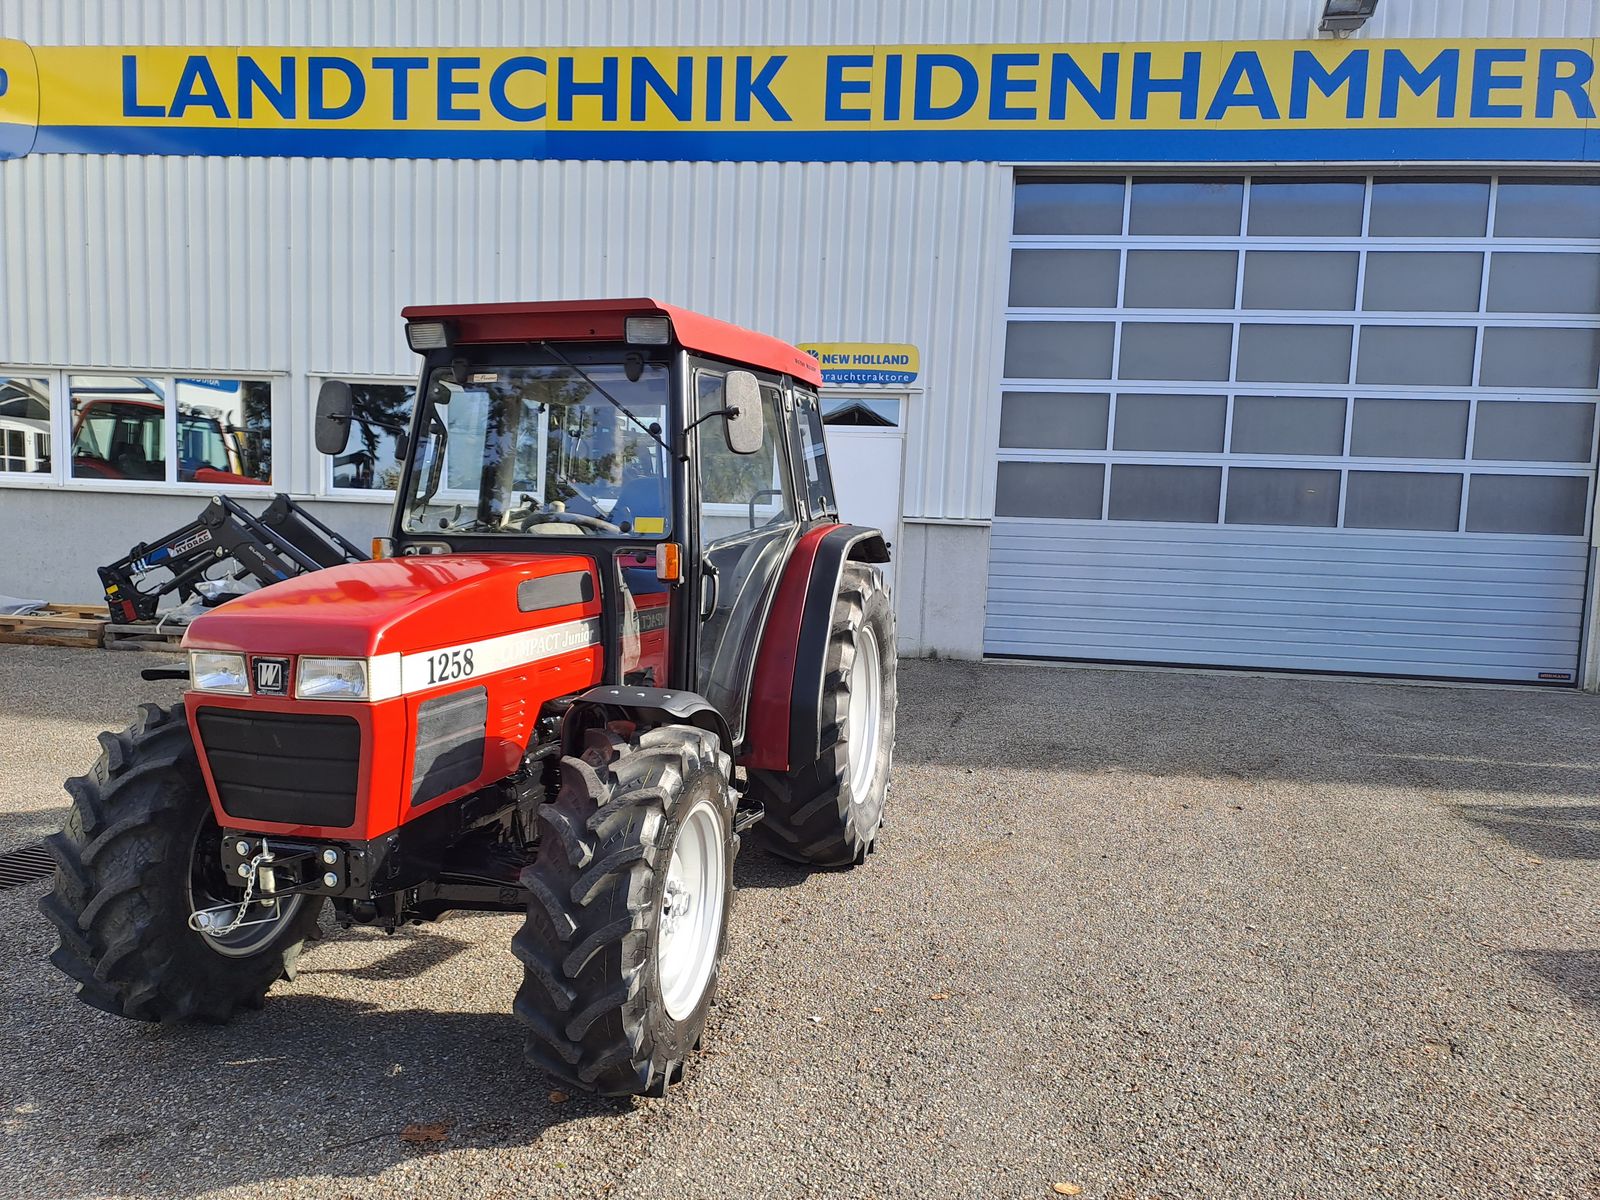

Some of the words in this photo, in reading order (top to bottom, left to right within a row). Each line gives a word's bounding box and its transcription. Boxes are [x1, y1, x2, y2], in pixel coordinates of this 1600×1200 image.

[121, 55, 793, 121] LANDTECHNIK
[823, 48, 1597, 121] EIDENHAMMER
[822, 354, 850, 364] NEW
[853, 354, 909, 365] HOLLAND
[175, 534, 210, 554] HYDRAC
[427, 648, 474, 685] 1258
[562, 627, 594, 648] Junior
